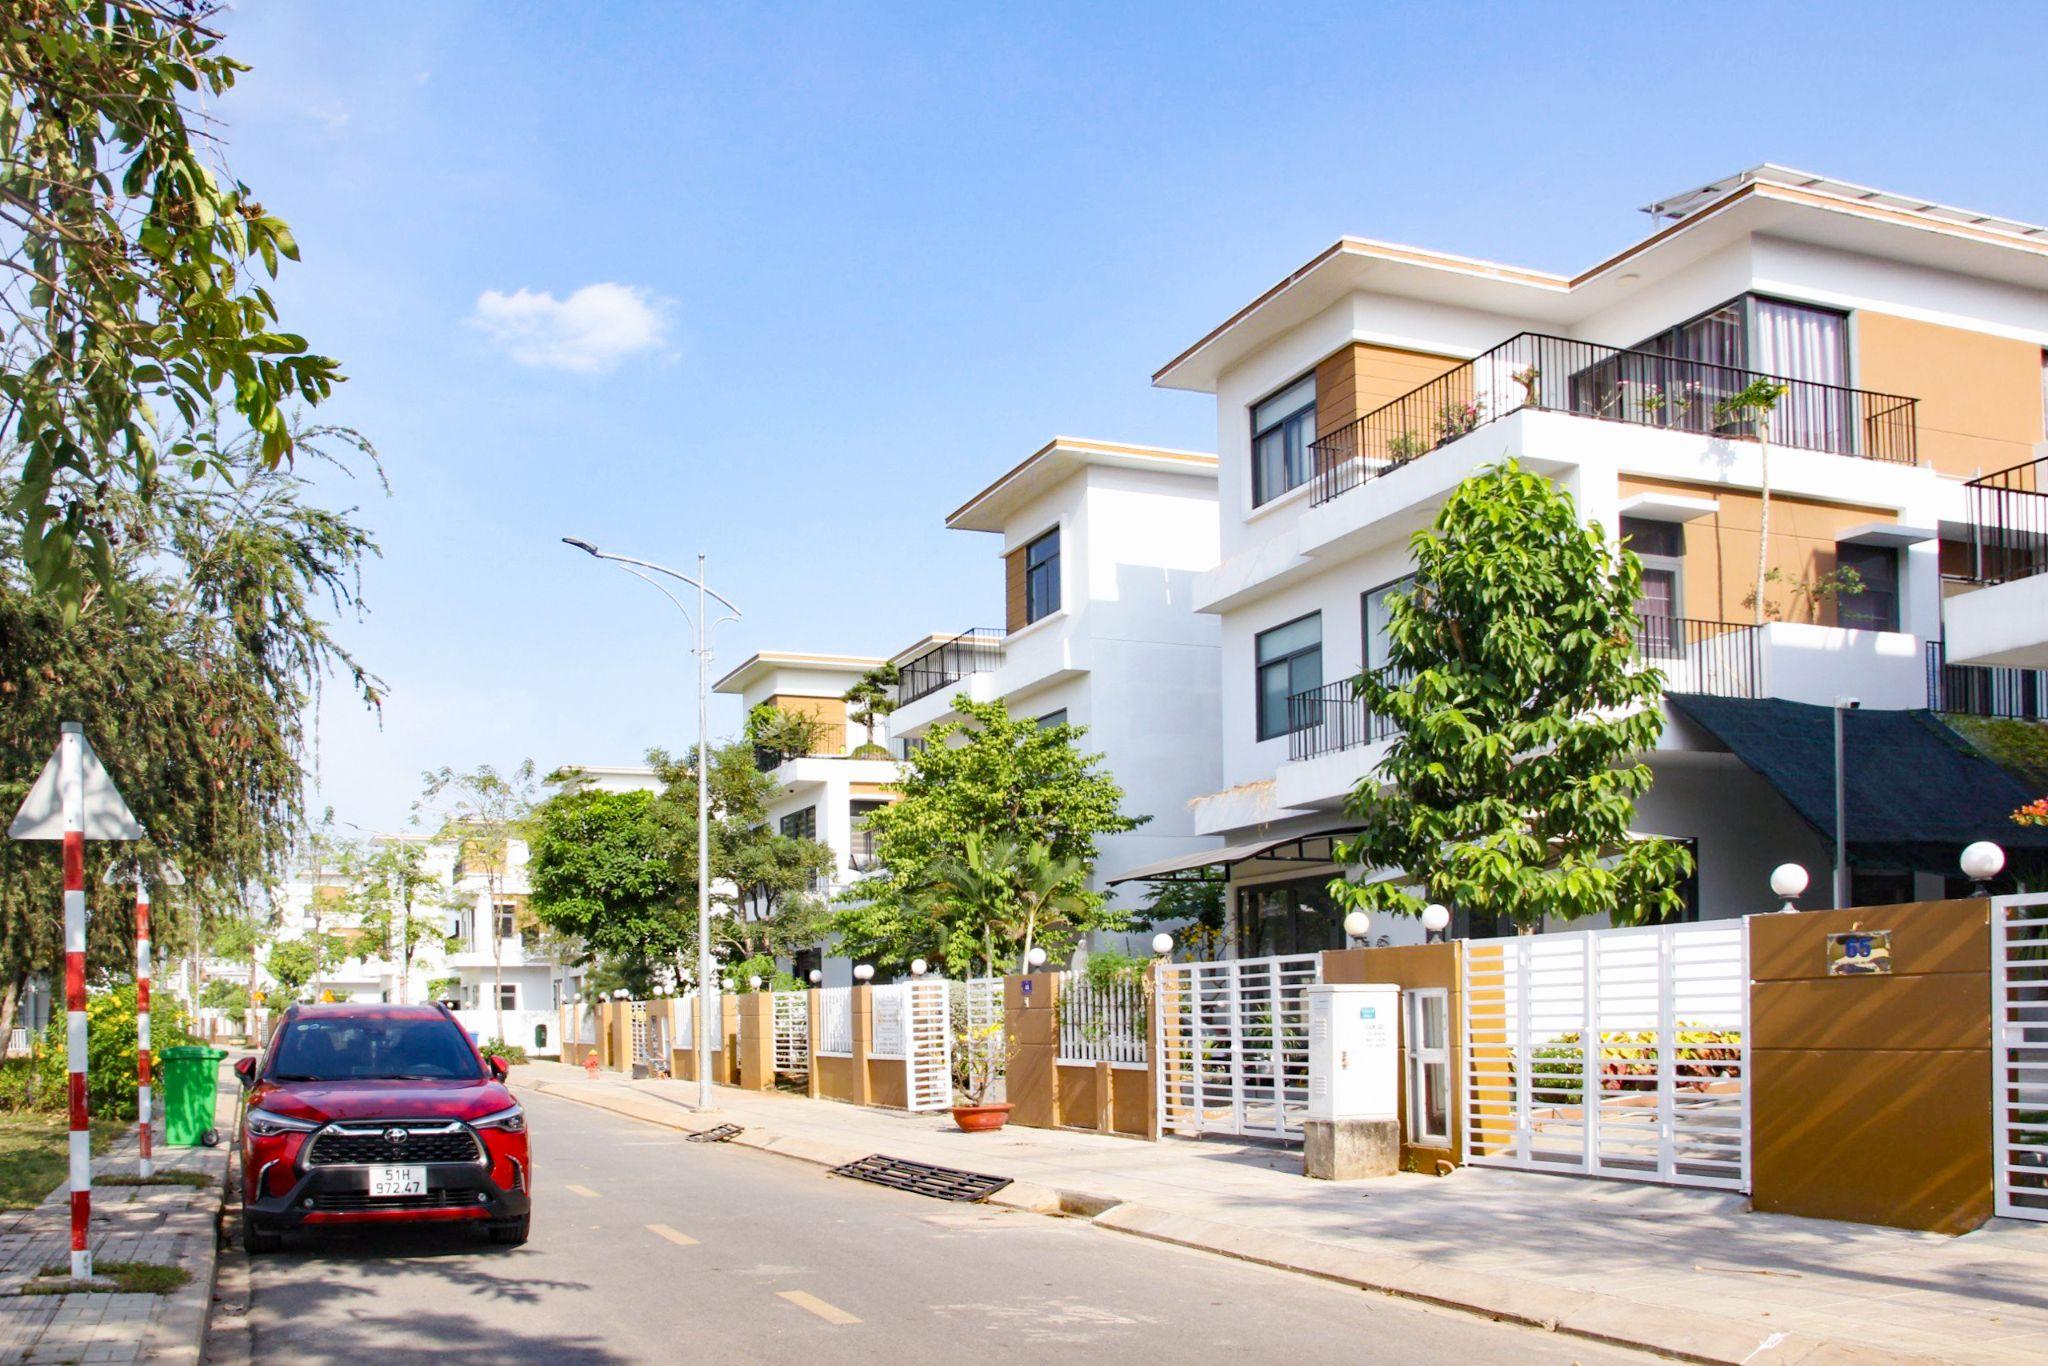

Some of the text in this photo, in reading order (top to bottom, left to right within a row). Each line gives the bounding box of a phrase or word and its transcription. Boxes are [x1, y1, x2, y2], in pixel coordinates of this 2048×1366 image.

[1846, 936, 1872, 958] 65
[385, 1169, 410, 1181] 51H
[376, 1181, 420, 1194] 972.47
